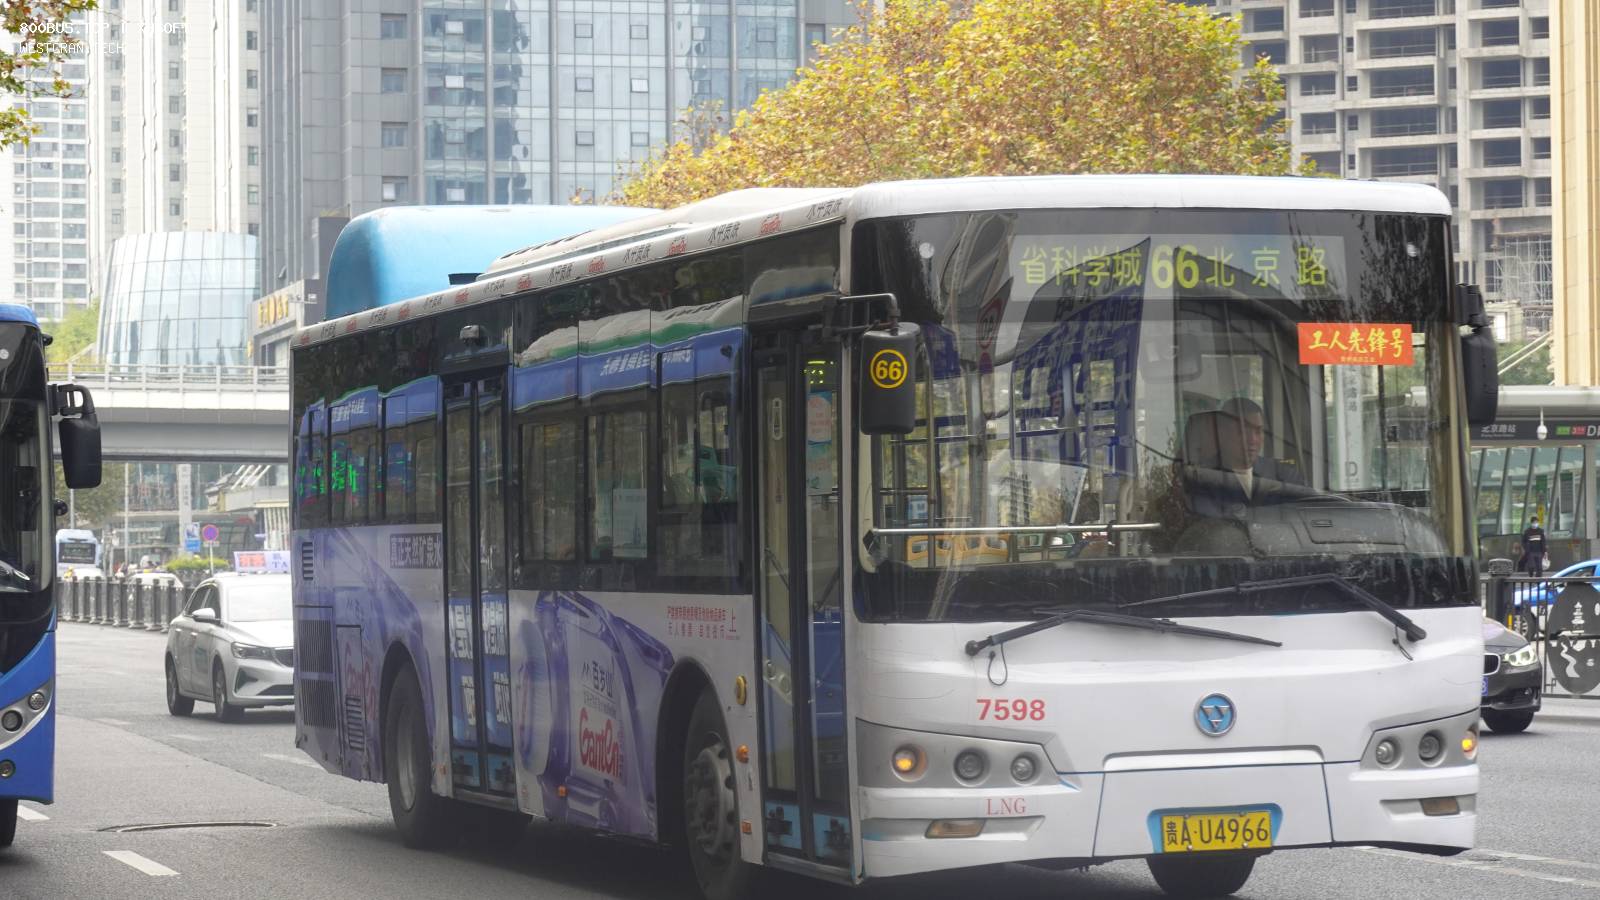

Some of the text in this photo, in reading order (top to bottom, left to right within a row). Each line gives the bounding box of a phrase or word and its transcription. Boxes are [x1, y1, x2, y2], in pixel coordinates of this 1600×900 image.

[1020, 245, 1142, 288] 省科学城
[1151, 244, 1200, 289] 66
[1308, 327, 1404, 359] 工人先锋号
[874, 359, 902, 382] 66
[1586, 425, 1600, 437] D
[976, 698, 1046, 722] 7598
[985, 797, 1027, 816] LNG
